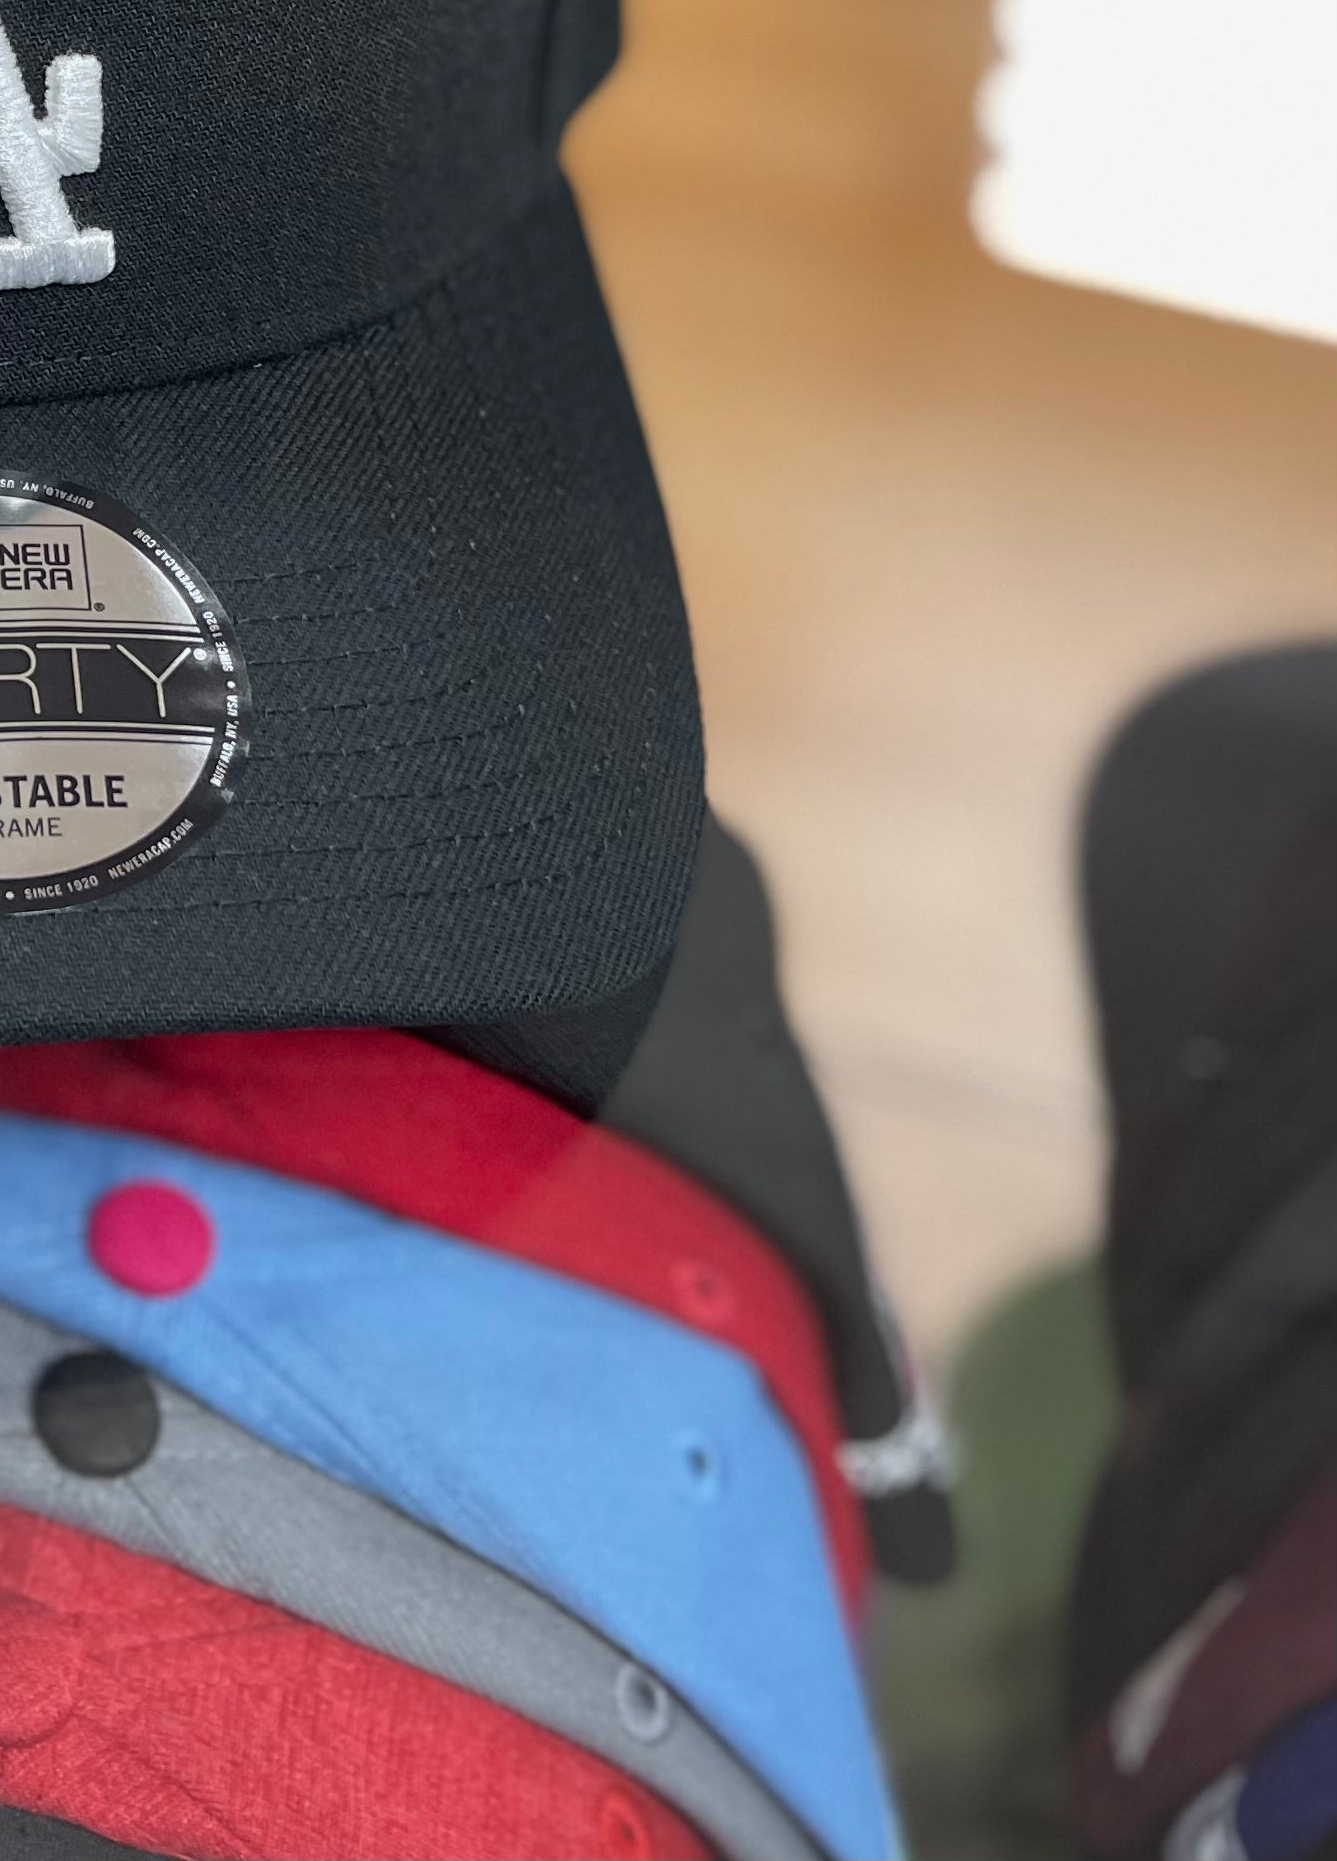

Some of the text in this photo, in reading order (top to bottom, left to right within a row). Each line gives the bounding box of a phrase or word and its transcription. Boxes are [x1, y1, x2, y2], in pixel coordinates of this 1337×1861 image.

[0, 567, 74, 591] ERA
[202, 610, 223, 639] 1920
[214, 640, 235, 673] SINCE
[226, 694, 240, 717] USA
[23, 883, 63, 901] SINCE
[66, 874, 99, 893] 1920
[107, 818, 195, 880] NEWERACAP.COM
